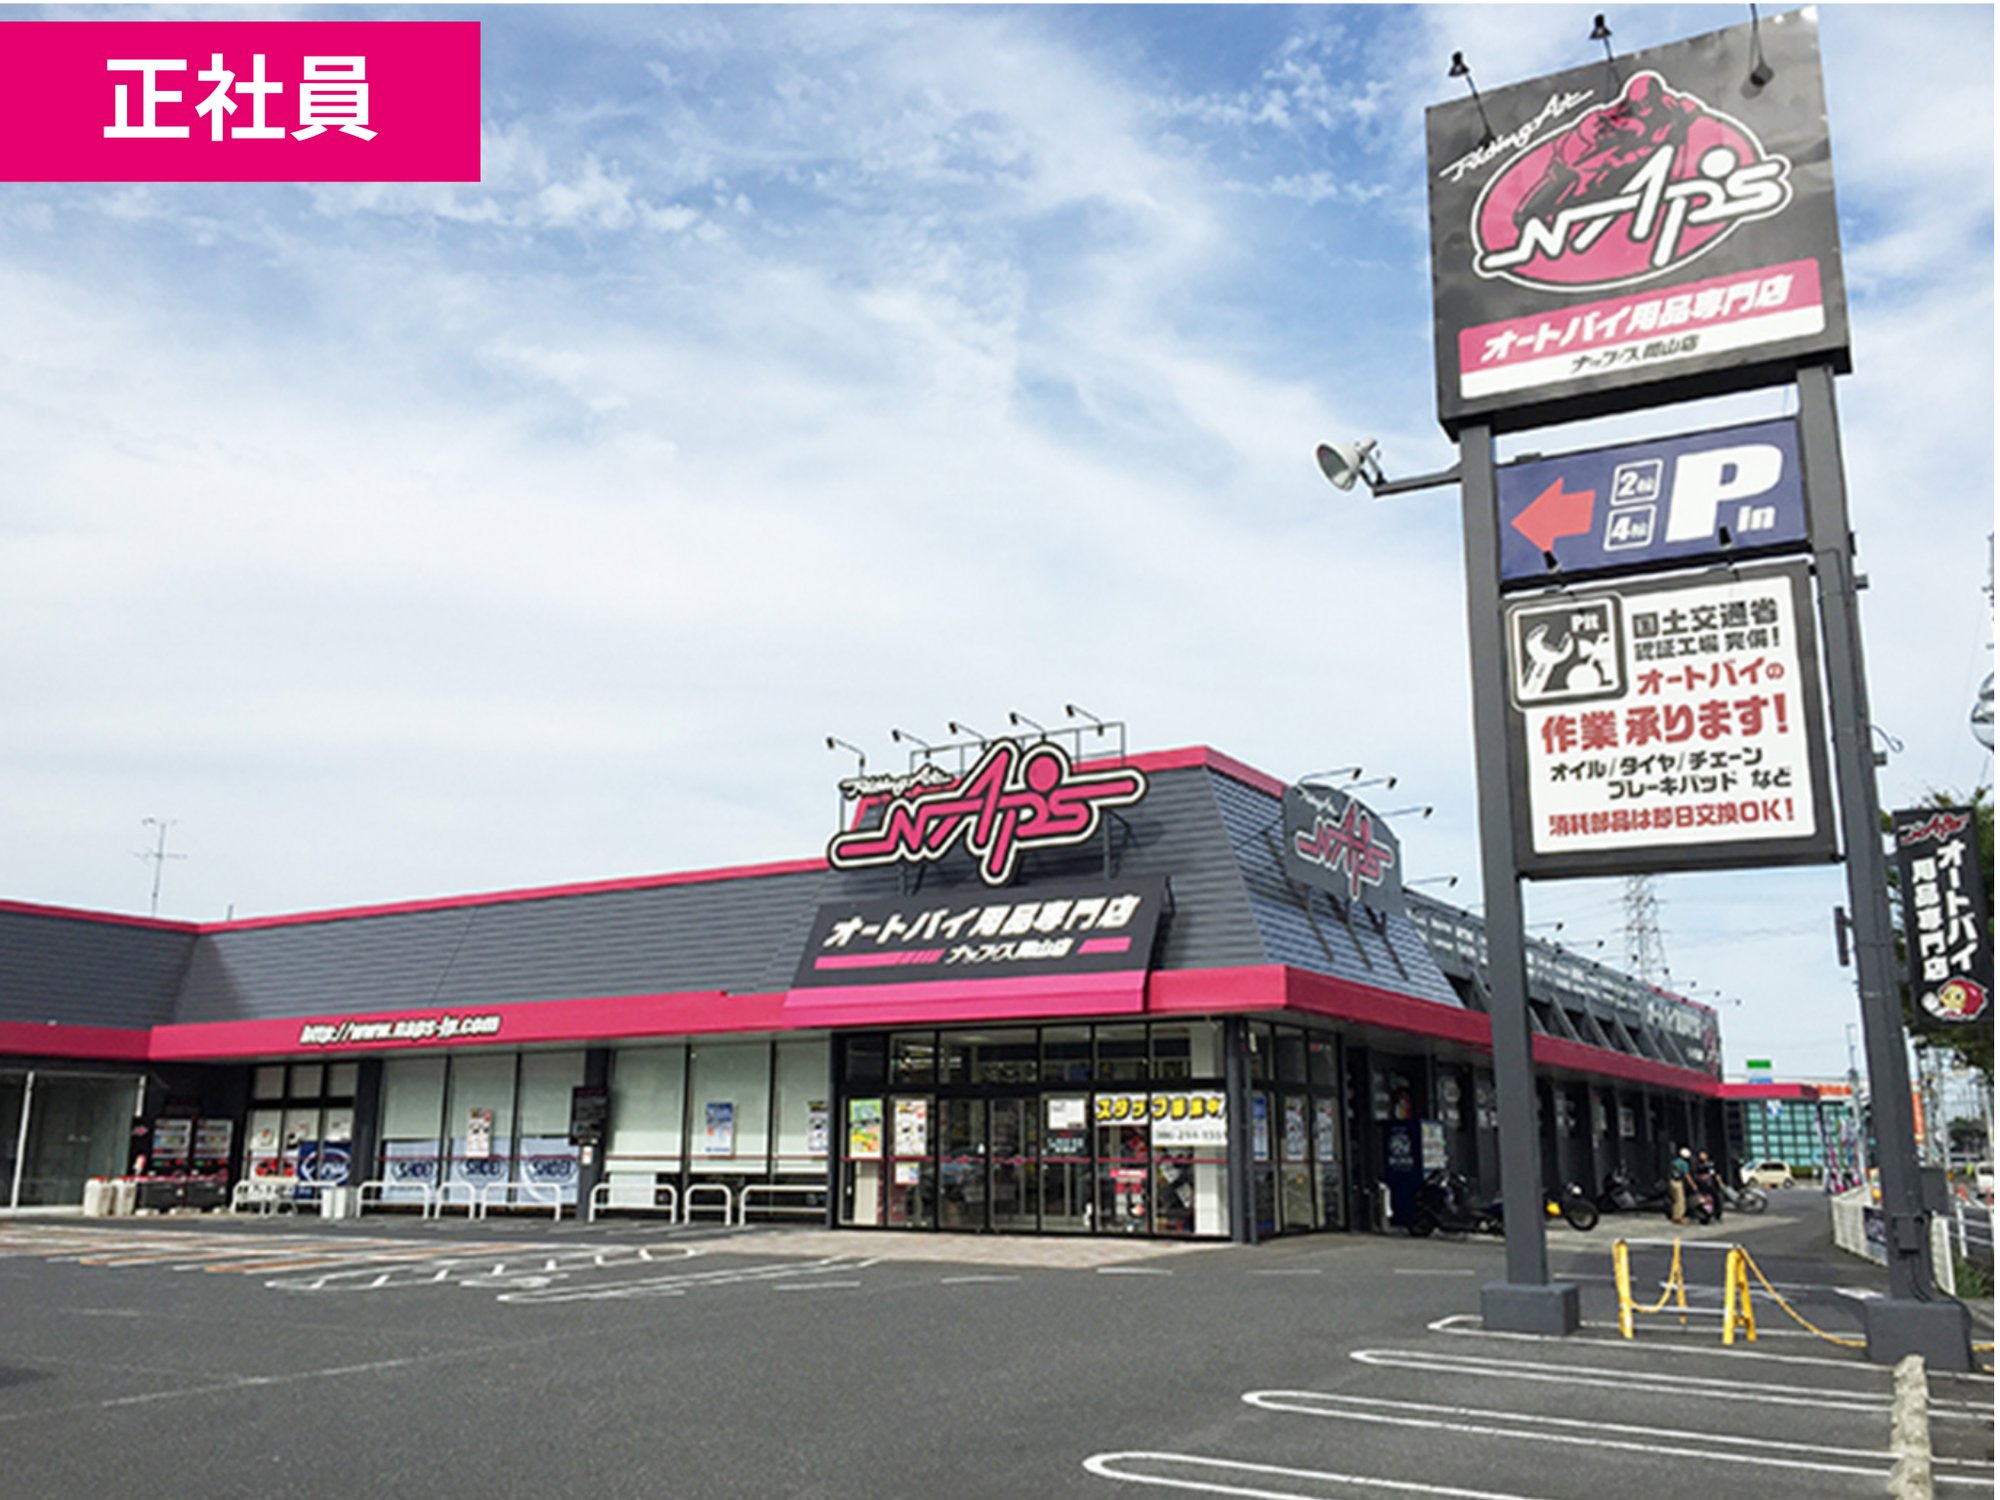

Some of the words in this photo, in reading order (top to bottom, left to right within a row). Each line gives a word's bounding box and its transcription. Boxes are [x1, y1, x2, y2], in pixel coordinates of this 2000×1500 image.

[1479, 274, 1794, 363] オートバイ用品専門店
[1665, 444, 1783, 543] P
[1737, 506, 1776, 533] in
[1571, 613, 1600, 633] Pit
[1632, 597, 1779, 639] 国土交通省
[1638, 657, 1785, 695] オートバイの
[1541, 710, 1618, 754] 作業
[1625, 693, 1788, 746] 承ります!
[1751, 767, 1793, 790] など
[822, 896, 1141, 947] オートバイ用品専門店
[1911, 856, 1950, 982] 用品専門店
[1937, 838, 1979, 972] オートバイ
